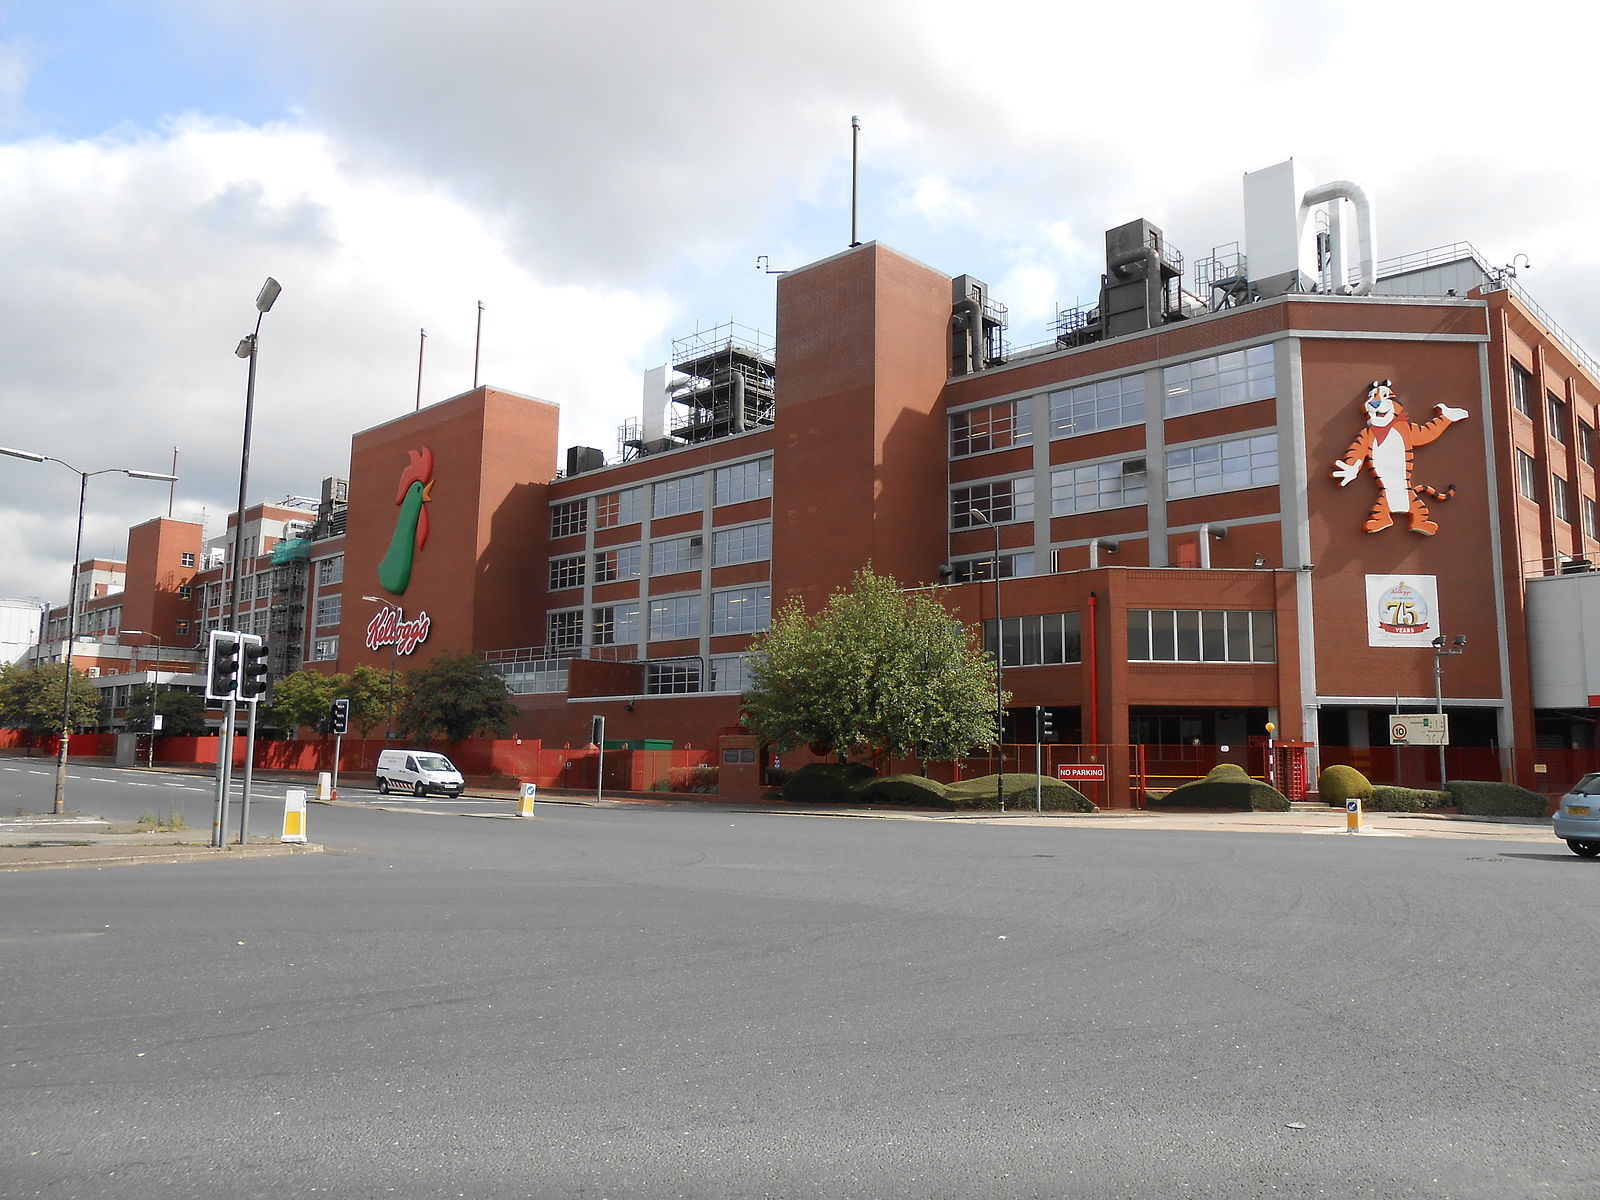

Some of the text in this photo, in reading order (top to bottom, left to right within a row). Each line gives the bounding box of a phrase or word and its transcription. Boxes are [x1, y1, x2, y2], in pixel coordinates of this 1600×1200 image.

[1386, 601, 1418, 625] 75
[366, 606, 431, 656] Kellogg's
[1395, 727, 1404, 736] 10
